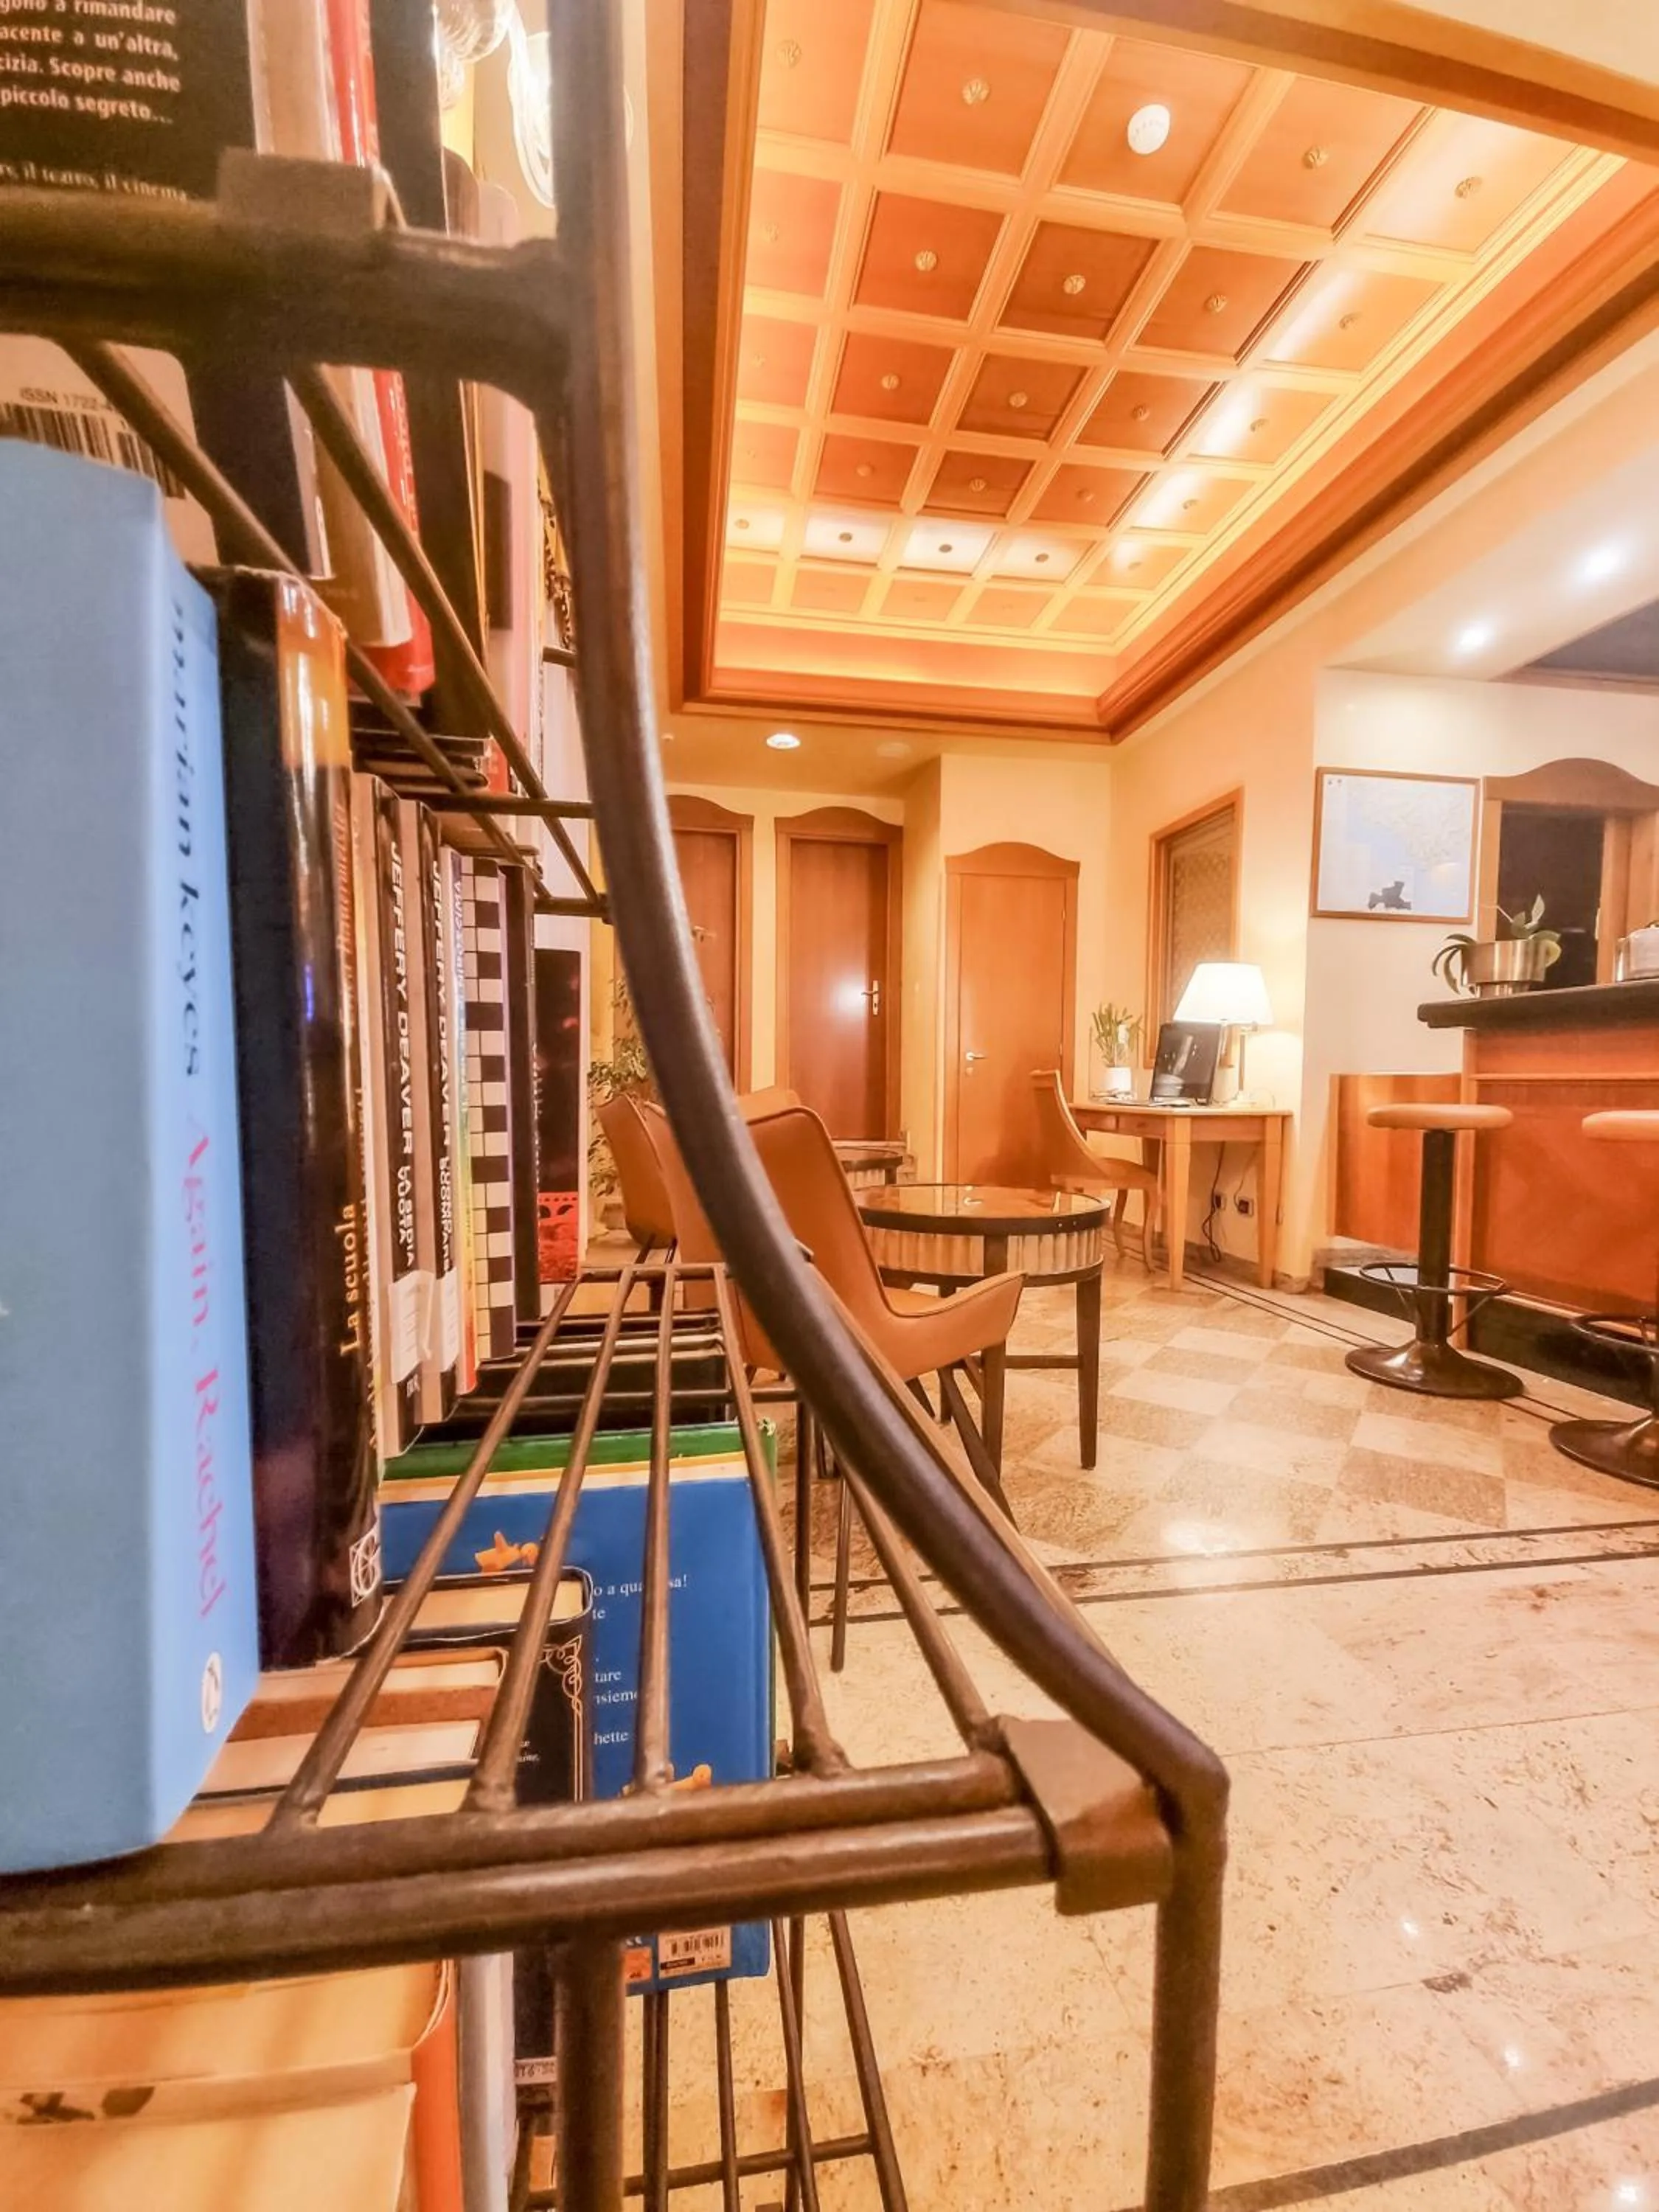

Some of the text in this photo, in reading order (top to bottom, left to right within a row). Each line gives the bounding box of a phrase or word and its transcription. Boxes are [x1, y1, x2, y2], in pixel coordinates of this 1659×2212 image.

[55, 0, 66, 13] a
[74, 0, 177, 25] rimandare
[0, 26, 180, 62] acente a un'altra,
[49, 56, 116, 83] Scopre
[122, 68, 182, 93] anche
[0, 84, 70, 109] piccolo
[19, 387, 58, 403] ISSN
[172, 596, 195, 856] marian
[179, 880, 200, 1076] keyes
[391, 841, 413, 1154] JEFFERY DEAVER
[433, 860, 451, 1145] JEFFERY DEAVER
[334, 1203, 361, 1356] La scuola
[195, 1369, 227, 1617] Rachel
[606, 1585, 616, 1596] a
[594, 1670, 622, 1683] tare
[593, 1731, 630, 1745] hette
